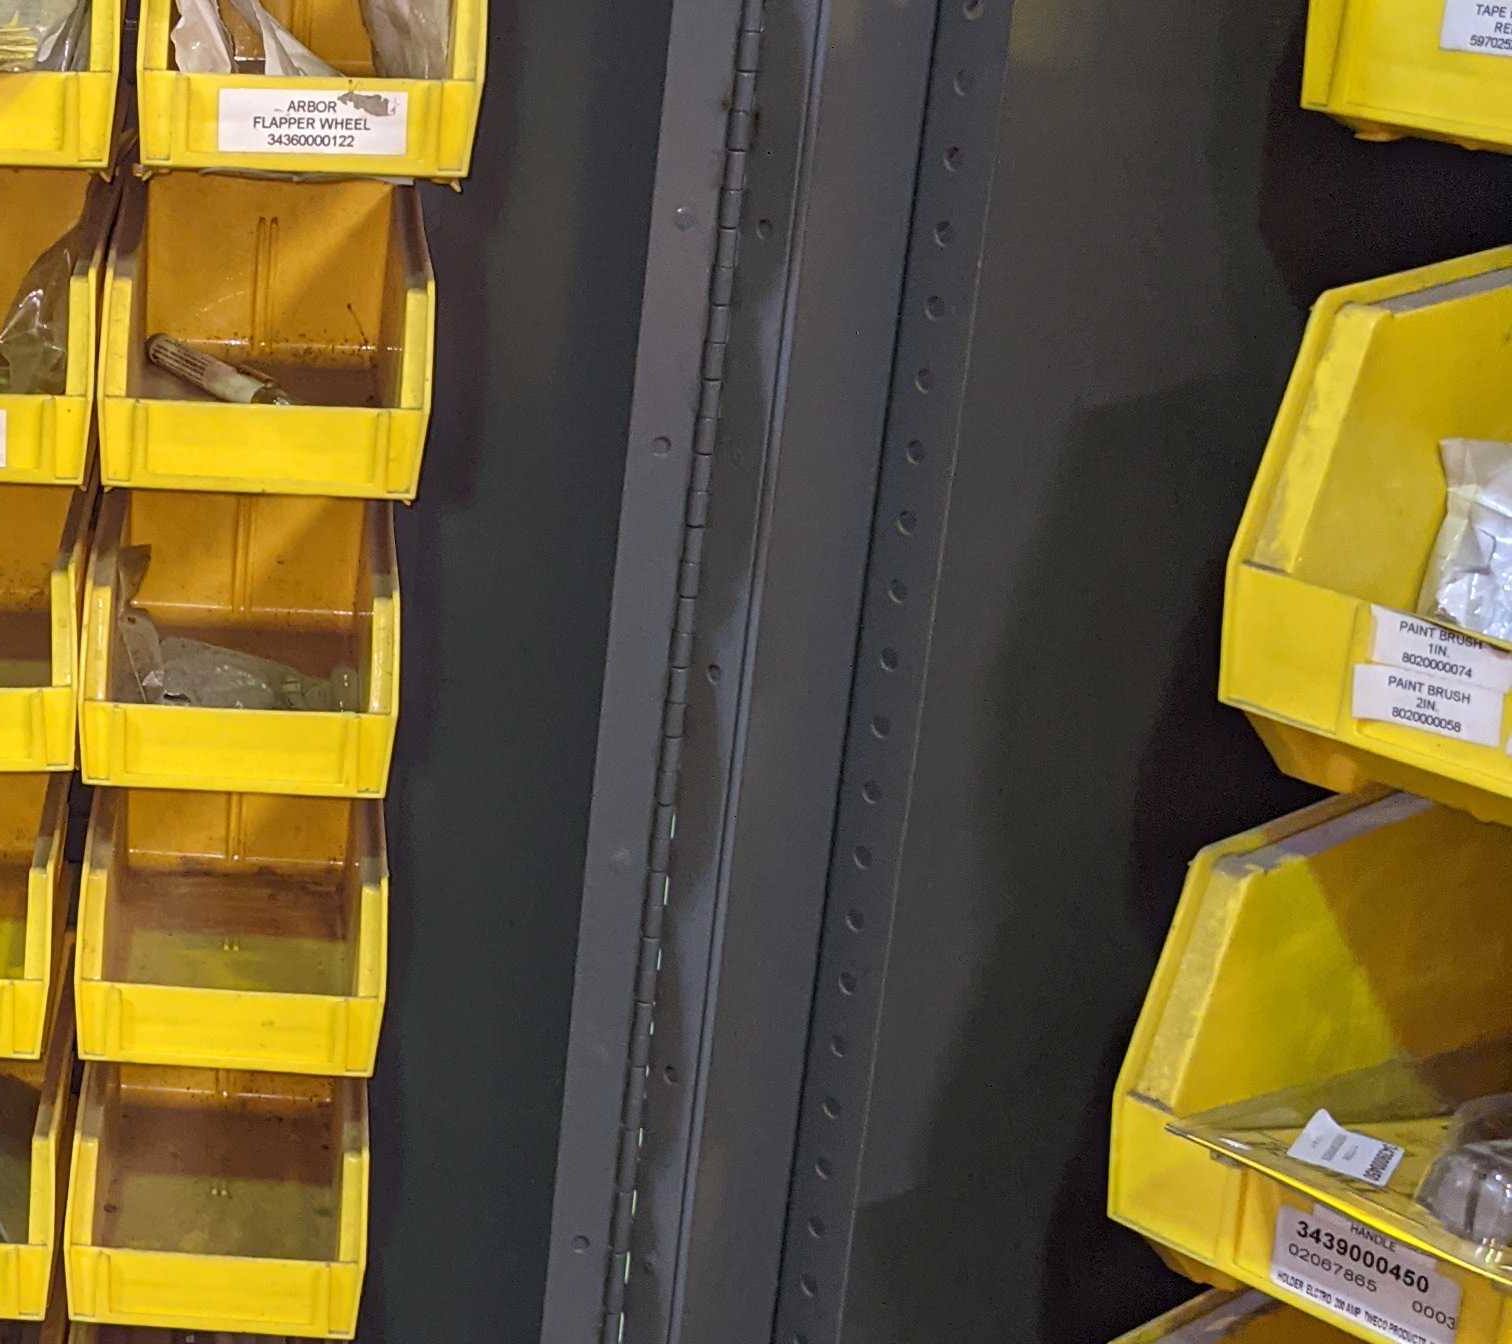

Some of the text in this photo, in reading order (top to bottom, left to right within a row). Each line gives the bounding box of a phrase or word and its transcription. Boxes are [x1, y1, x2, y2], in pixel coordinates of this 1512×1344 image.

[1476, 3, 1507, 18] TAPE
[1494, 22, 1512, 35] RE
[287, 100, 337, 113] ARBOR
[253, 116, 371, 131] FLAPPER WHEEL
[267, 134, 355, 148] 34360000122
[1399, 620, 1483, 649] PAINT BRUSH
[1401, 652, 1473, 678] 8020000074
[1388, 675, 1471, 704] PAINT BRUSH
[1391, 706, 1462, 733] 8020000058
[1350, 1221, 1397, 1253] HANDLE
[1288, 1243, 1377, 1293] 02067865
[1296, 1220, 1429, 1293] 3439000450
[1277, 1271, 1304, 1290] HOLDER
